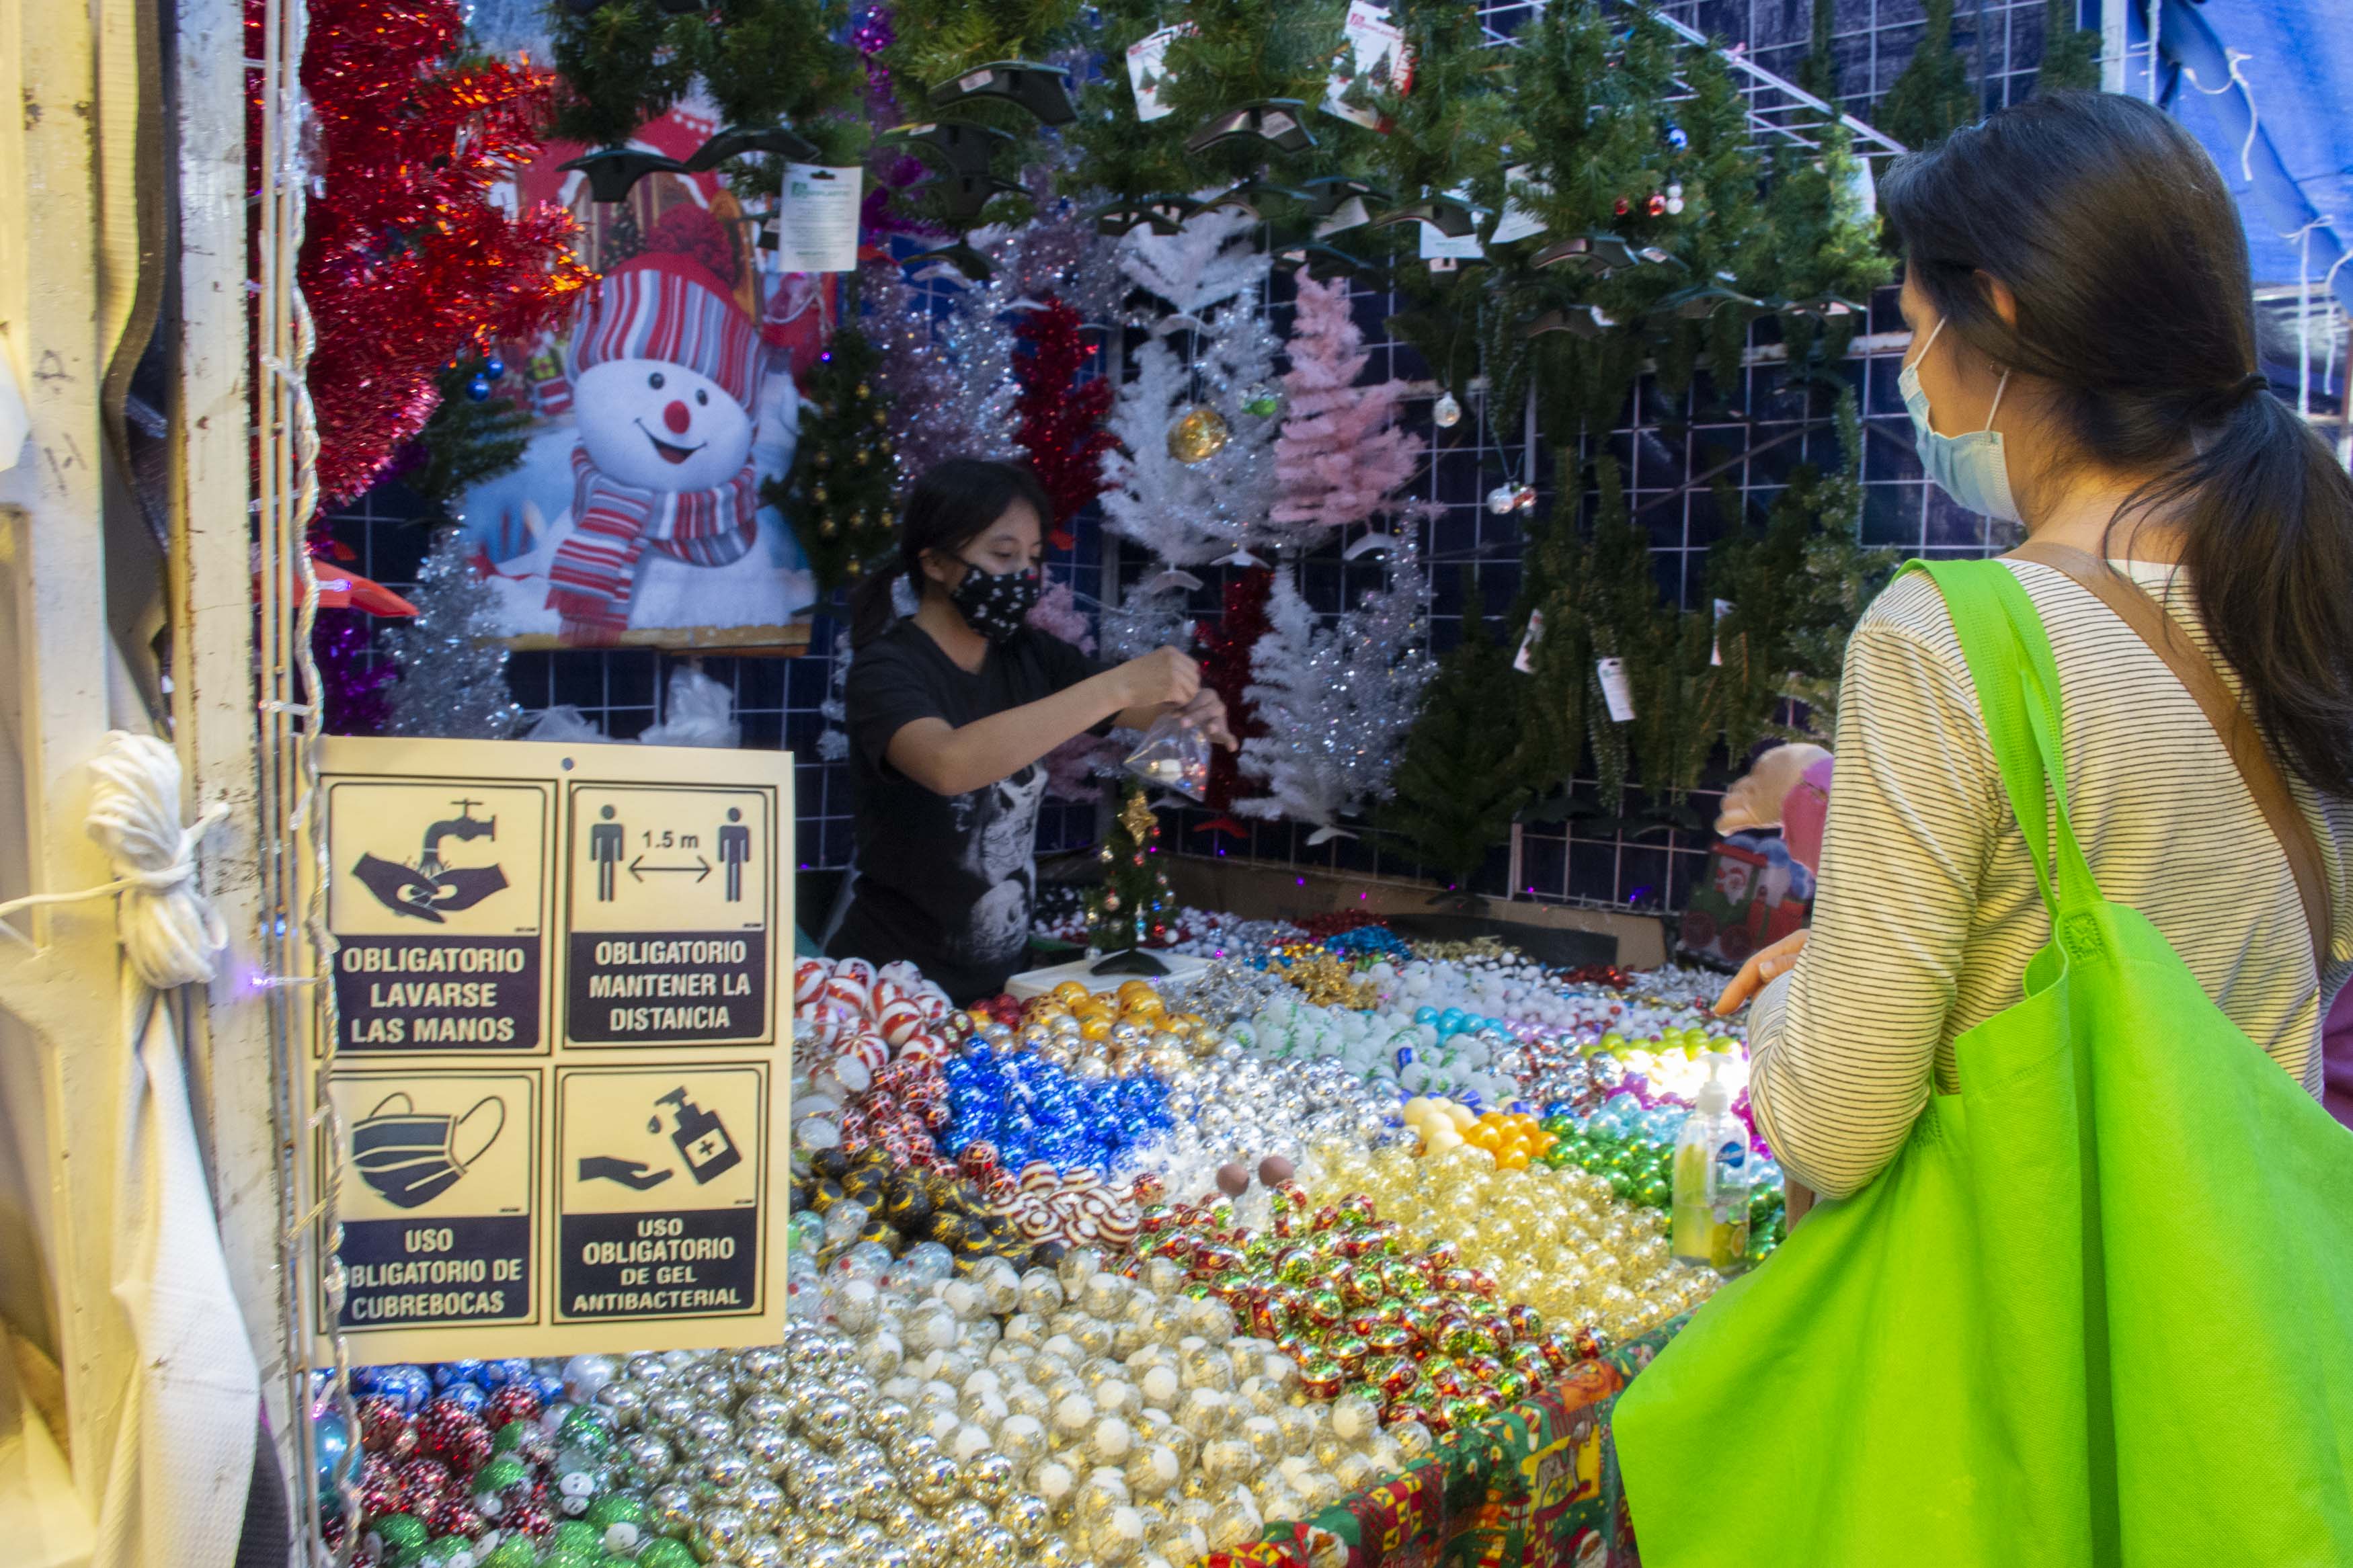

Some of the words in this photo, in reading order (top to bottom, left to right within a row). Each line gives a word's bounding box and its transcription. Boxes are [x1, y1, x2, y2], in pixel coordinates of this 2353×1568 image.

[643, 831, 674, 848] 1.5
[681, 835, 699, 848] m
[343, 948, 524, 973] OBLIGATORIO
[596, 940, 746, 965] OBLIGATORIO
[371, 983, 497, 1007] LAVARSE
[590, 974, 716, 997] MANTENER
[723, 973, 751, 995] LA
[352, 1018, 404, 1042] LAS
[414, 1018, 514, 1042] MANOS
[610, 1006, 729, 1030] DISTANCIA
[638, 1218, 682, 1237] USO
[406, 1229, 452, 1252] USO
[583, 1237, 735, 1264] OBLIGATORIO
[493, 1259, 522, 1281] DE
[621, 1268, 649, 1285] DE
[657, 1266, 697, 1284] GEL
[353, 1292, 505, 1321] CUBREBOCAS
[573, 1289, 741, 1313] ANTIBACTERIAL
